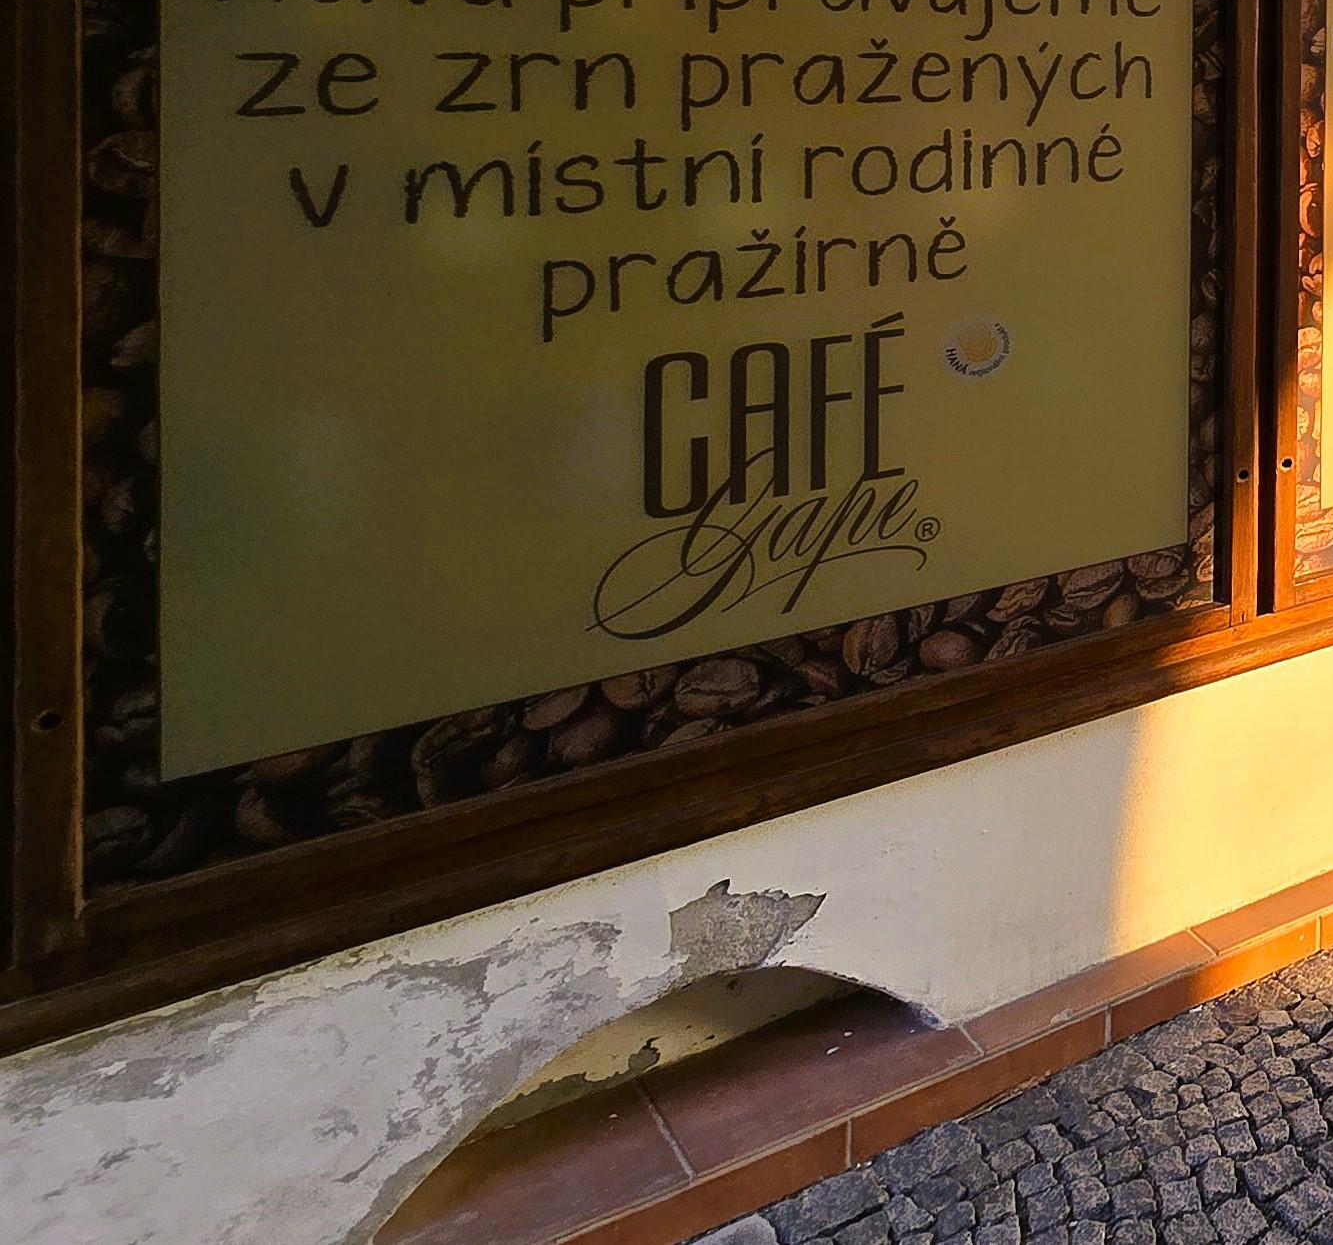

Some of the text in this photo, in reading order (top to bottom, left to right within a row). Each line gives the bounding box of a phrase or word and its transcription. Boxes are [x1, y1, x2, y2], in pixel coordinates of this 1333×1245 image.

[236, 39, 1152, 130] ze zrn pražených
[289, 124, 1125, 228] v místní rodinné
[540, 216, 967, 343] pražírně
[643, 312, 905, 520] CAFÉ
